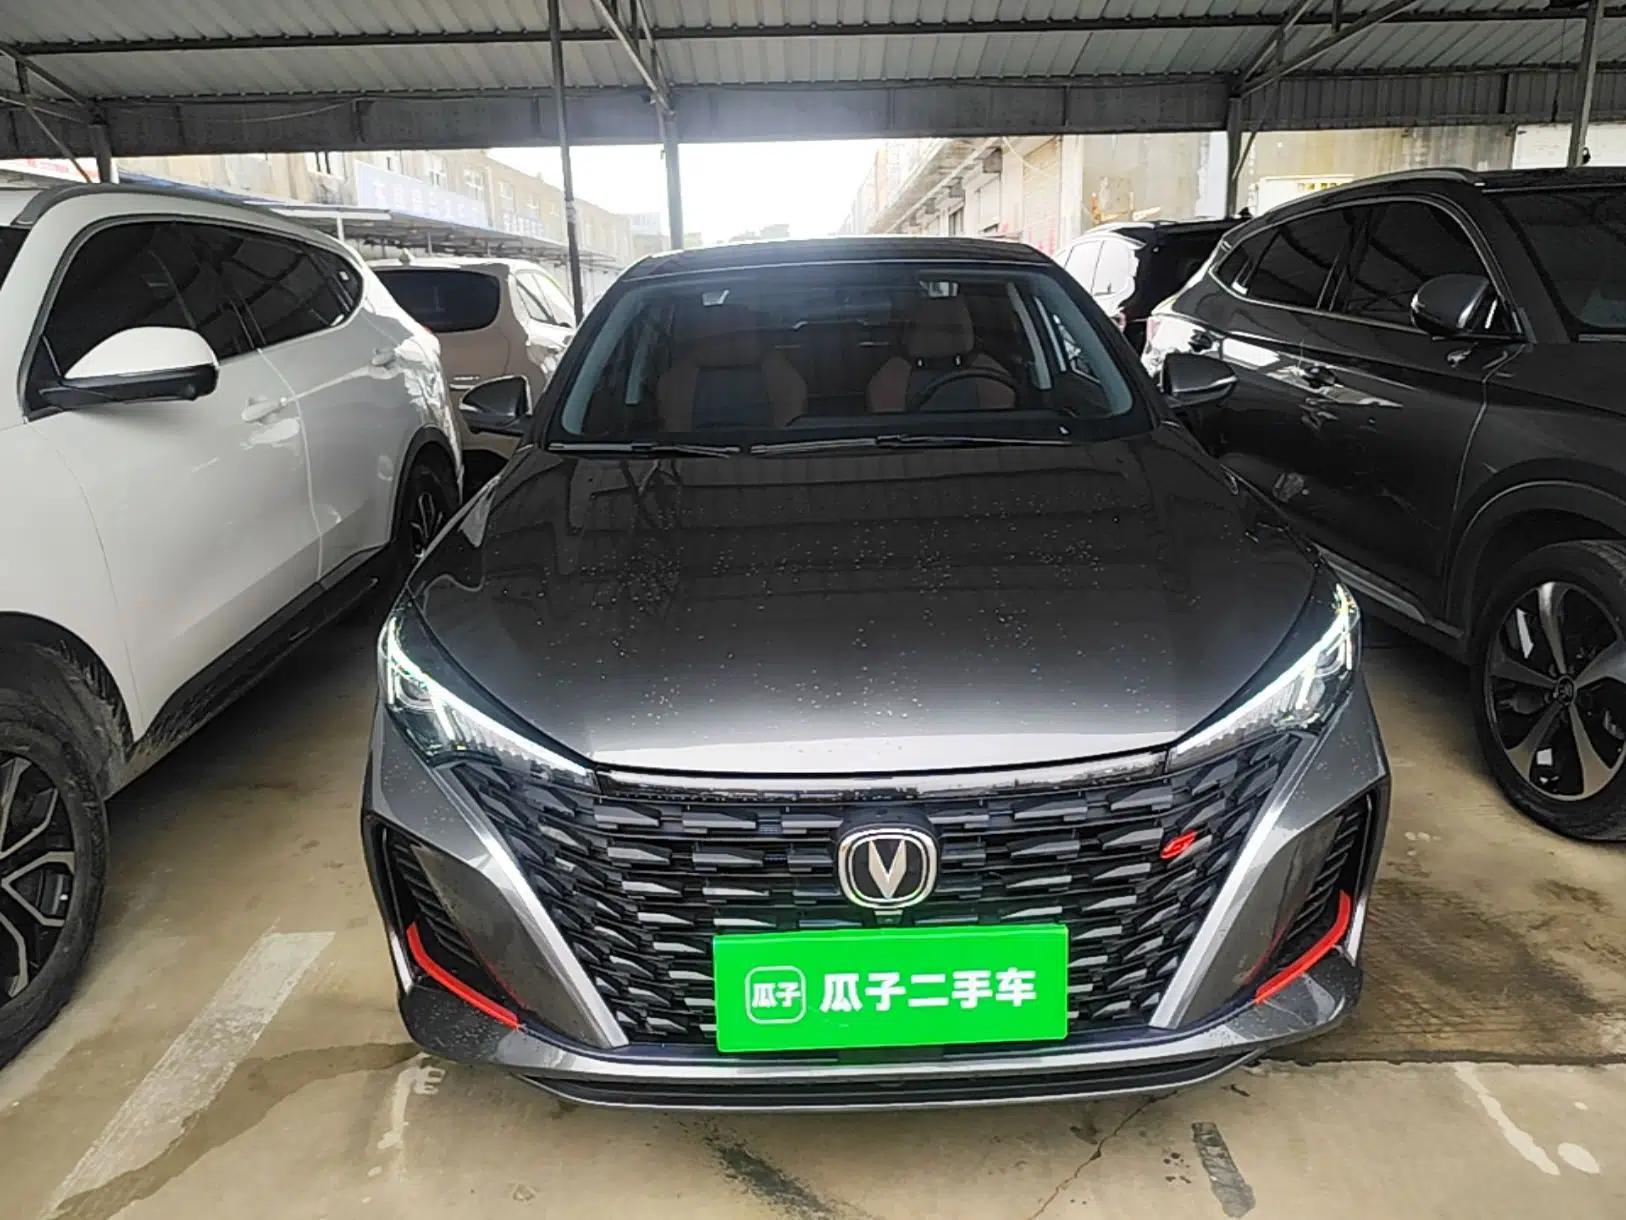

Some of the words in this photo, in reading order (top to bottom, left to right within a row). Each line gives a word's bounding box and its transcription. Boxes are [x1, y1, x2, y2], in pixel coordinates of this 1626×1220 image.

[751, 981, 802, 1009] 瓜子
[819, 967, 1037, 1013] 瓜子二手车
